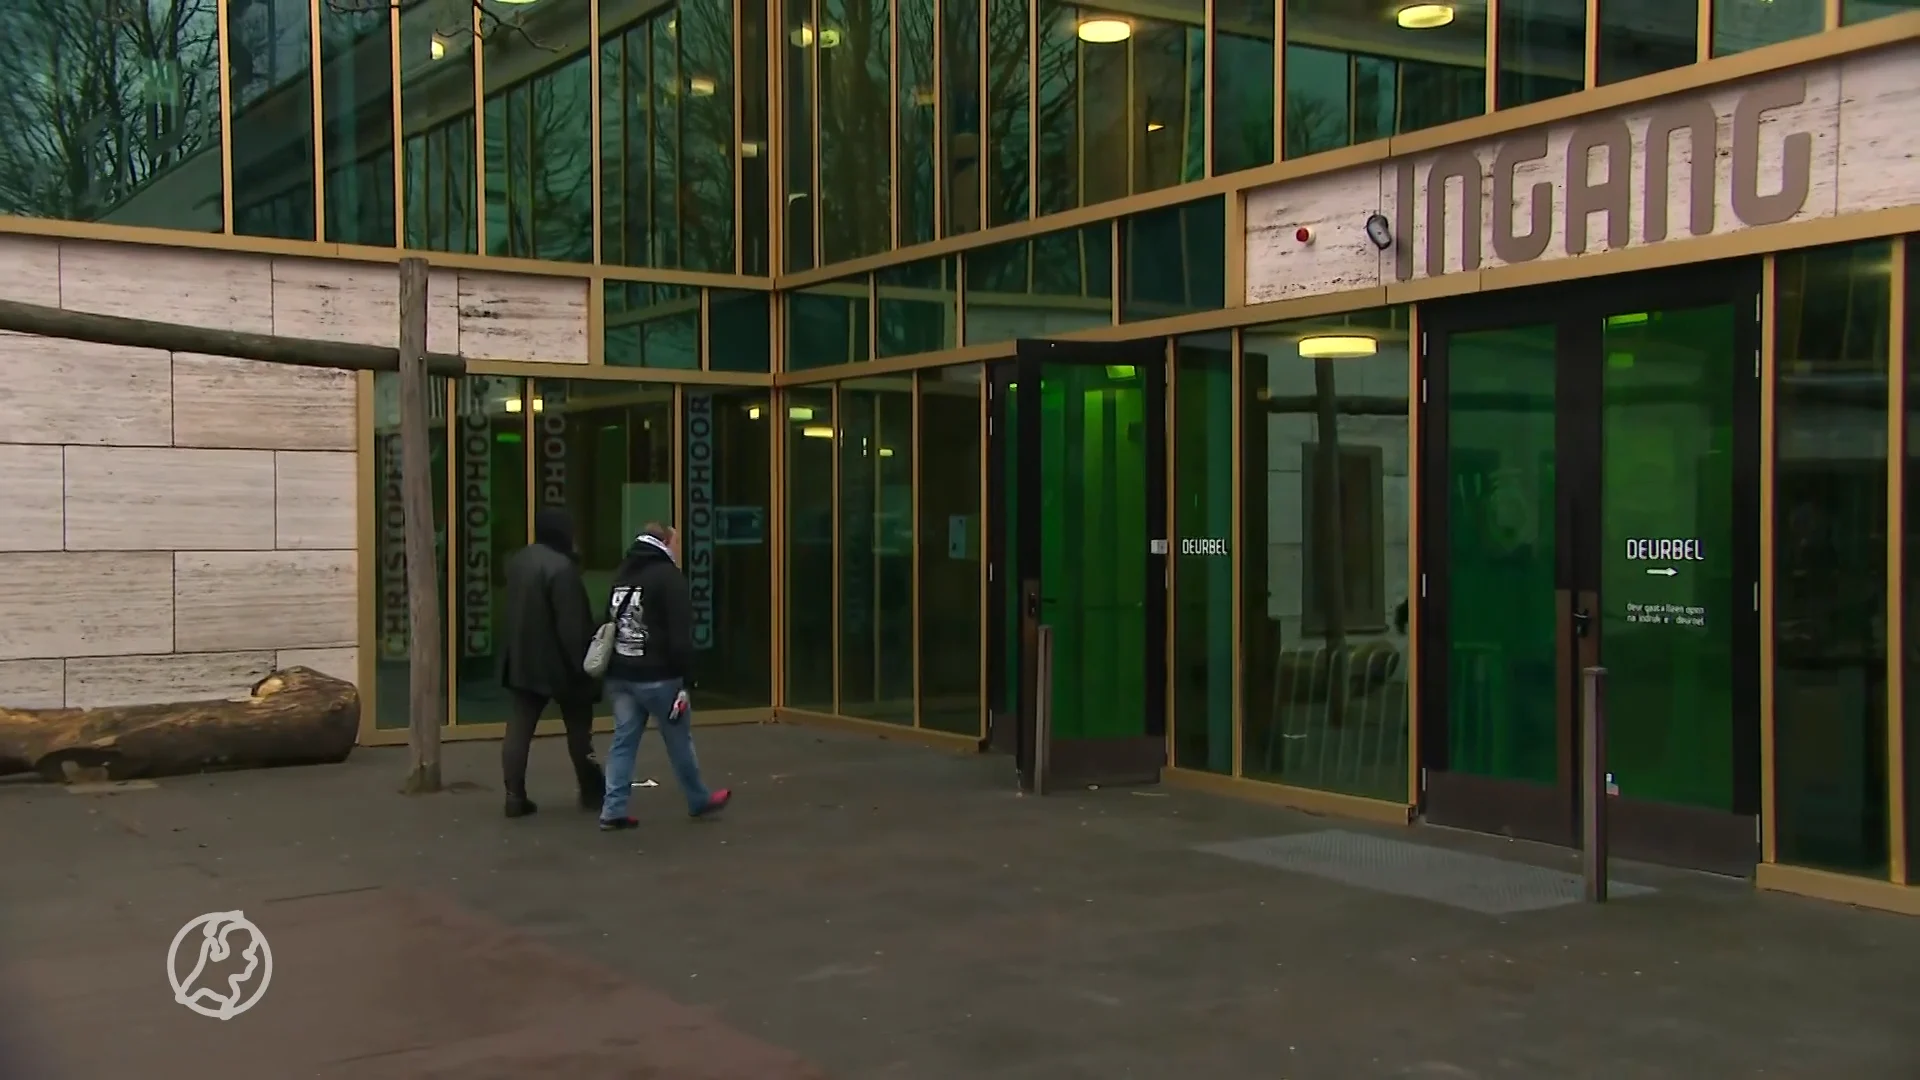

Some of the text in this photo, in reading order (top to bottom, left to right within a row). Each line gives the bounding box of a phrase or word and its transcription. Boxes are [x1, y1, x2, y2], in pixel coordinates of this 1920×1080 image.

[1395, 78, 1811, 281] INGANG
[691, 395, 711, 645] CHRISTOPHOOR
[1182, 538, 1227, 555] DEURBEL
[1626, 539, 1704, 560] DEURBEL
